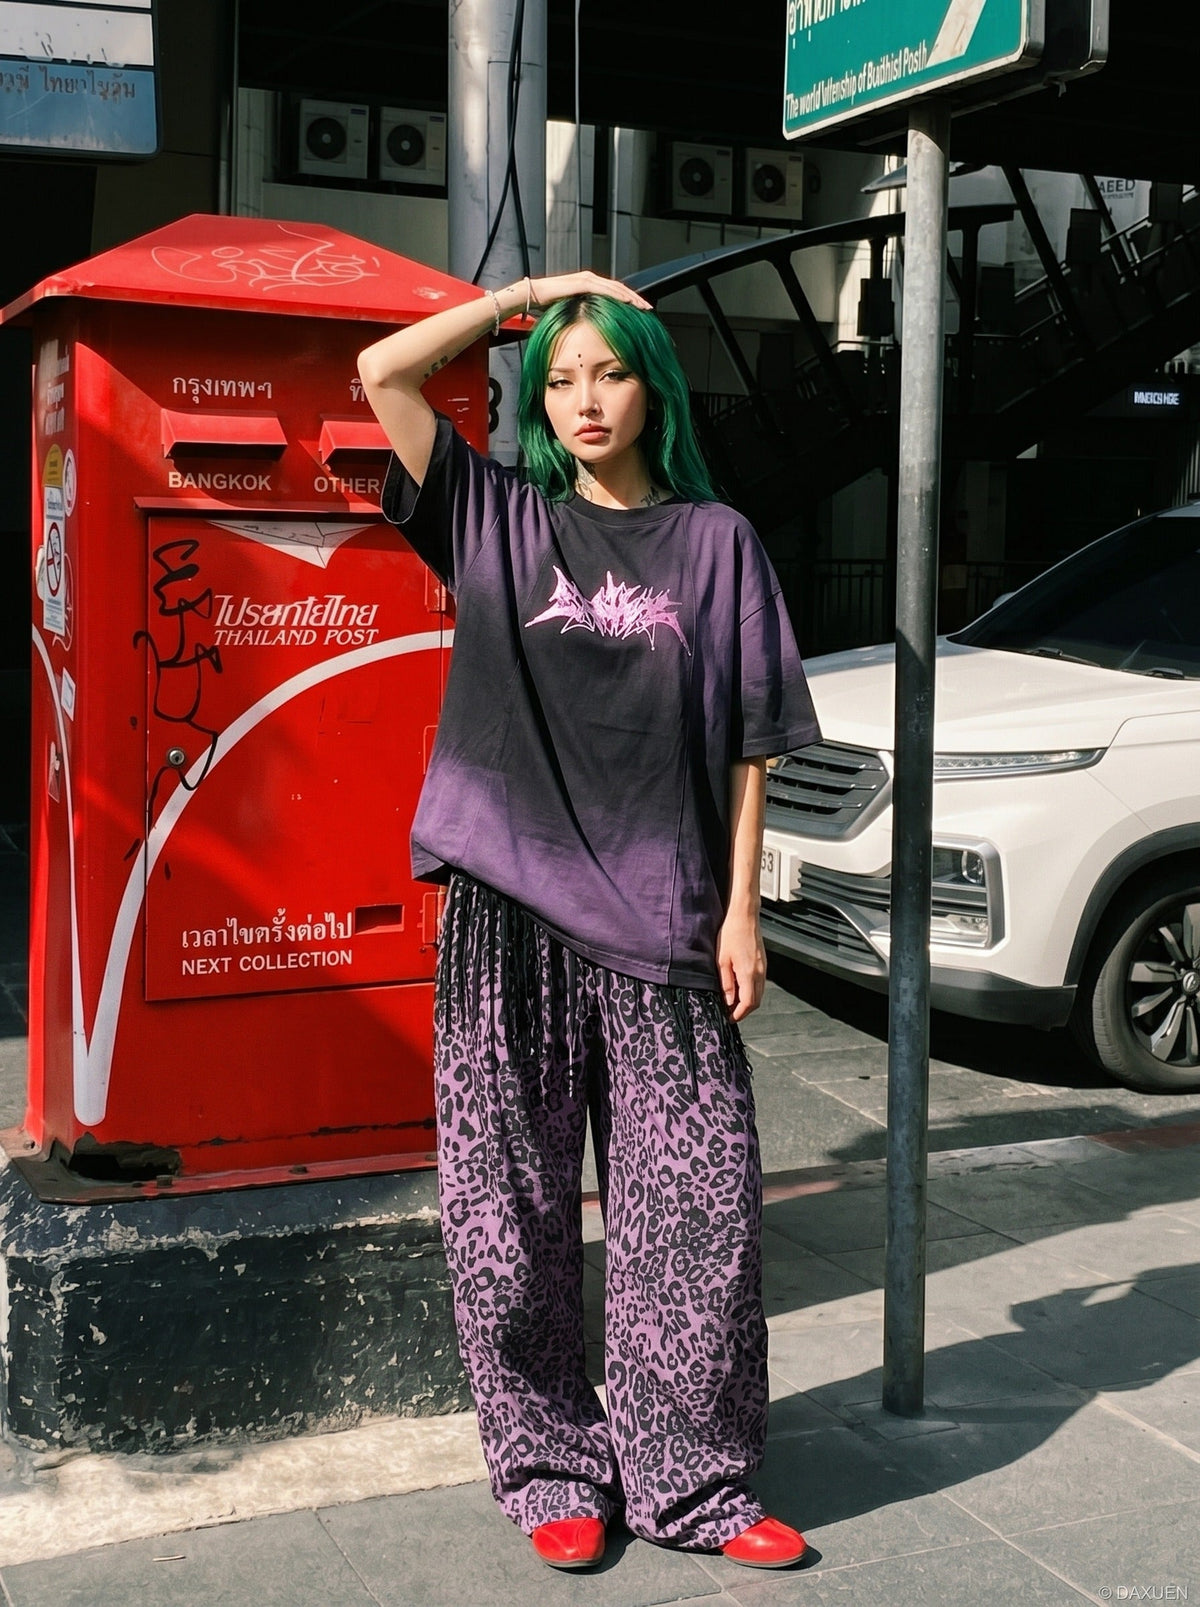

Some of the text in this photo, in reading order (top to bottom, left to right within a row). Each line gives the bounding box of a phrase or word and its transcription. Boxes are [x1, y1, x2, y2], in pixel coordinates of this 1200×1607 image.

[857, 63, 867, 93] of
[168, 471, 380, 494] BANGKOK OTHER
[214, 629, 379, 646] THAILAND POST
[182, 949, 352, 976] NEXT COLLECTION
